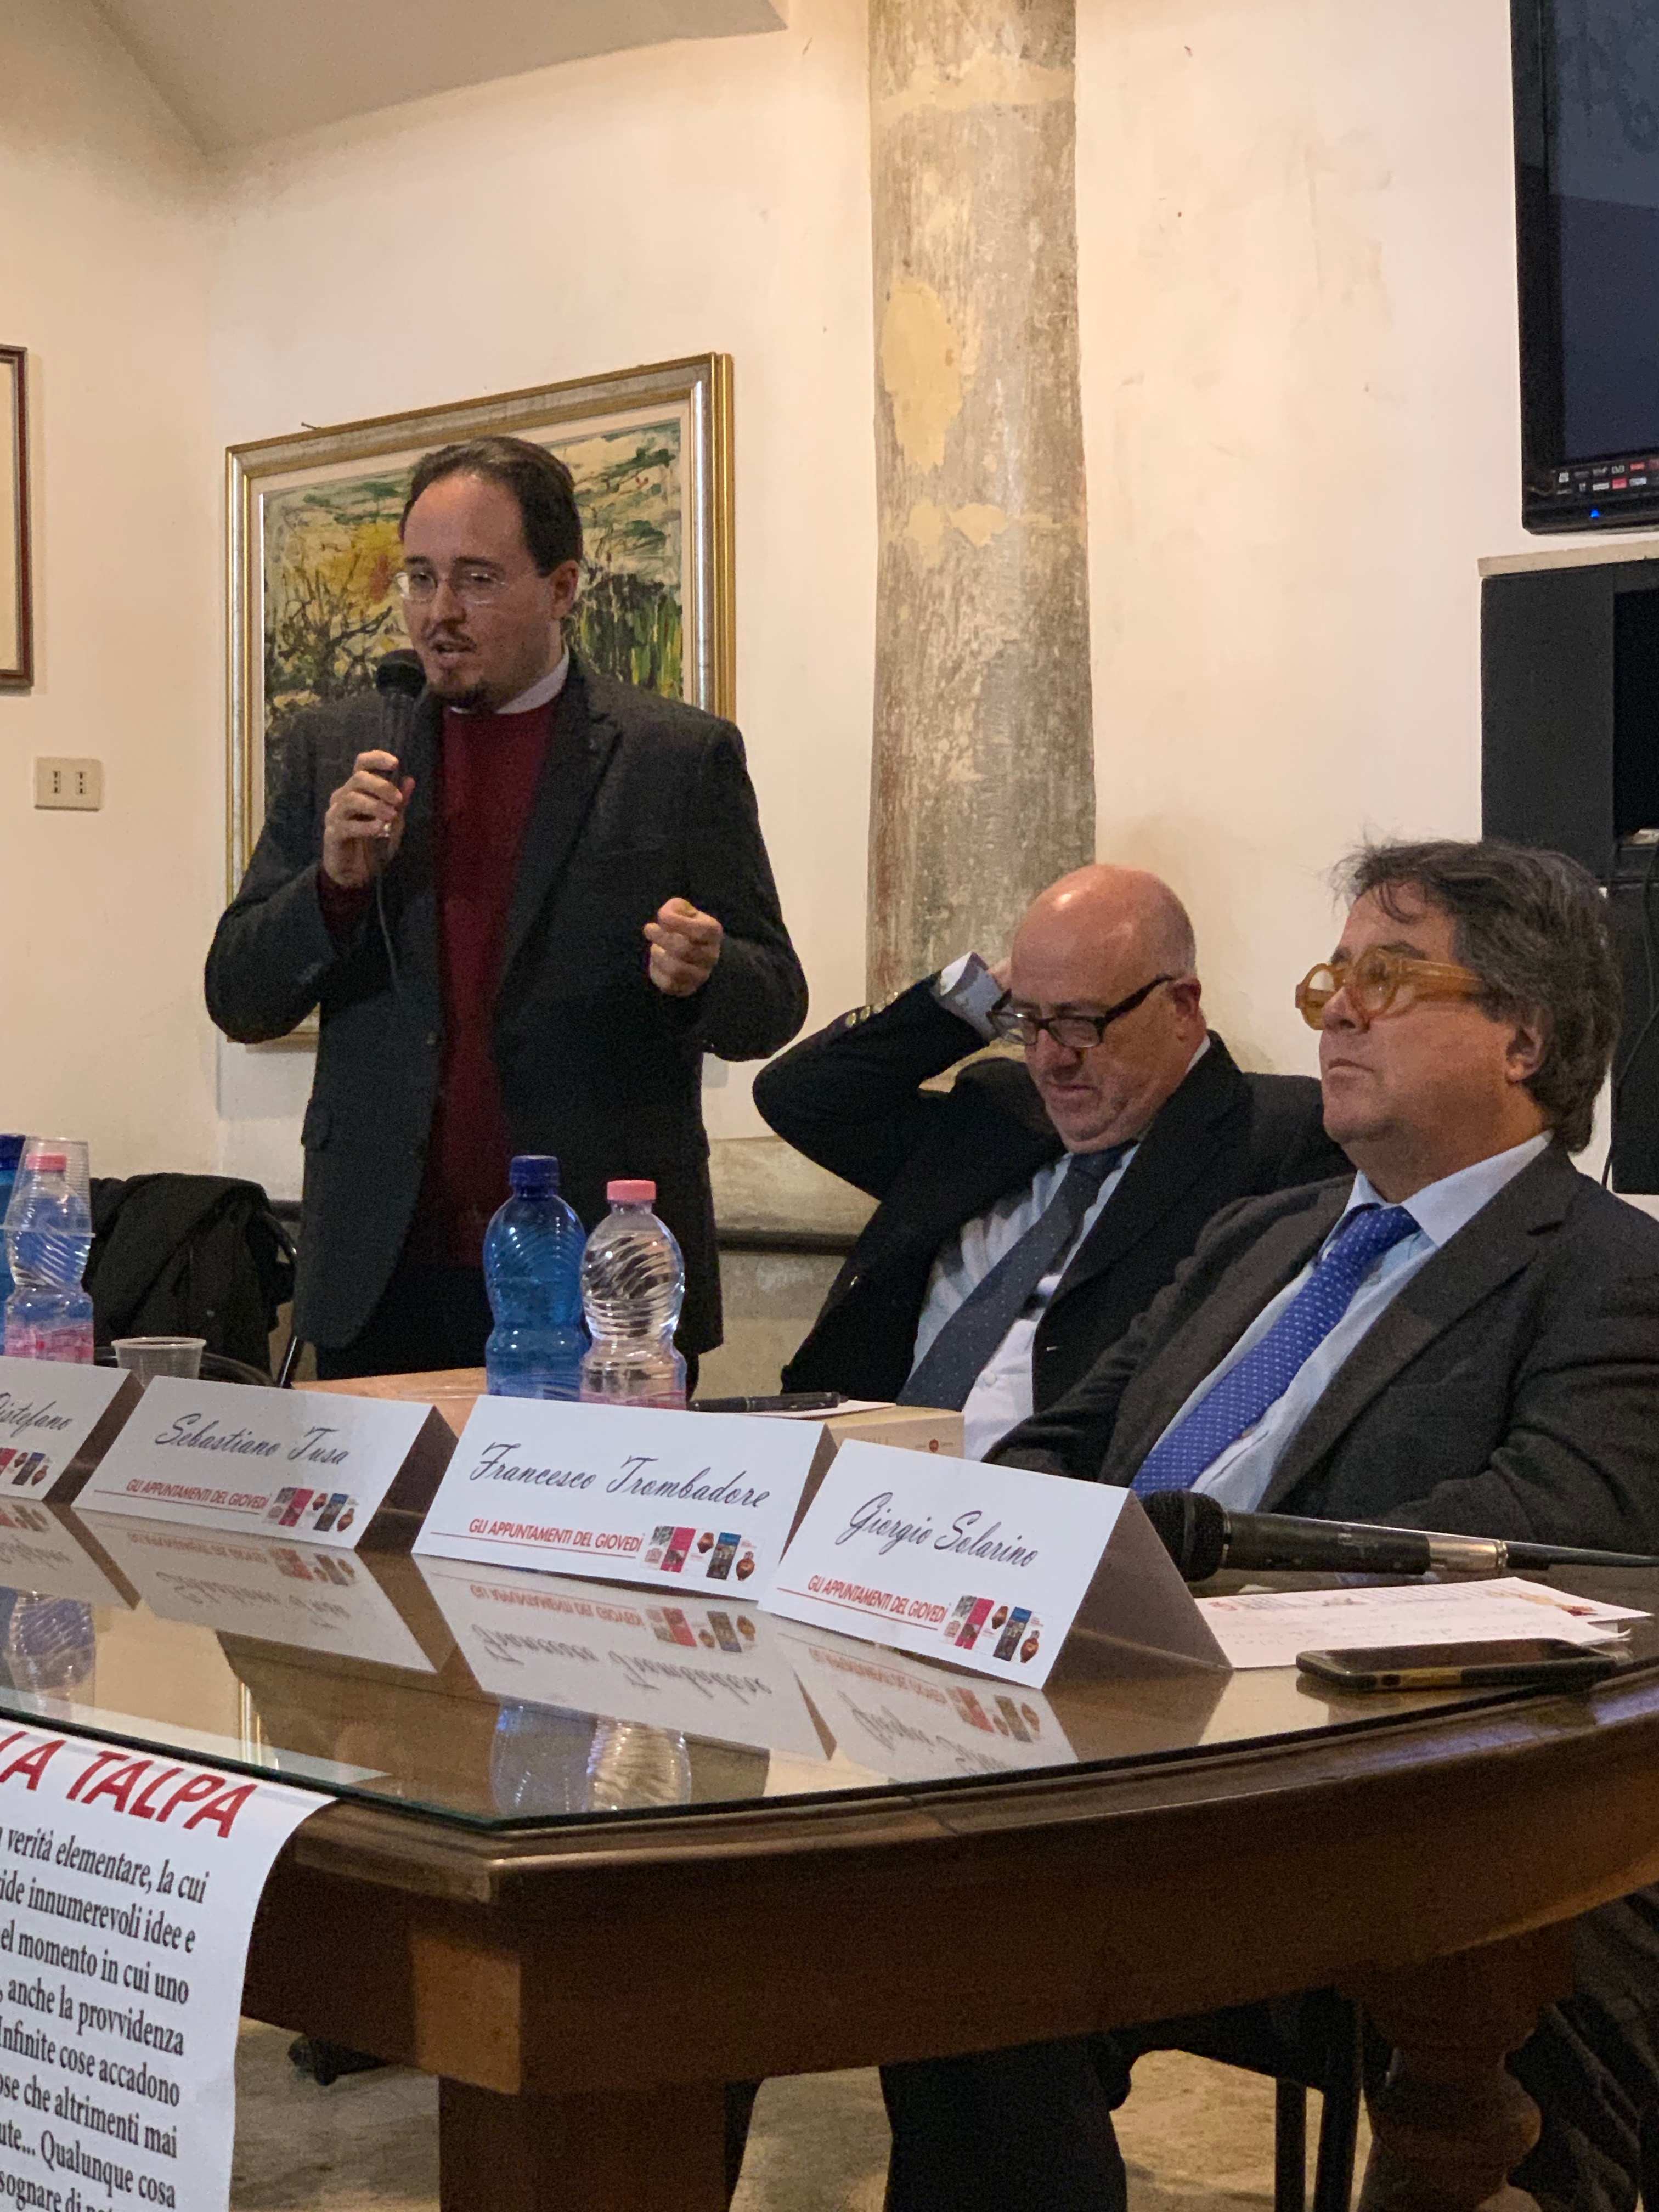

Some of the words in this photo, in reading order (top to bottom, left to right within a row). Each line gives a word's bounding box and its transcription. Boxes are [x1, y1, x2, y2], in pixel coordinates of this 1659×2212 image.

[155, 1413, 281, 1458] Sebastiano
[287, 1426, 349, 1465] Tusa
[469, 1441, 597, 1489] Francesco
[606, 1455, 770, 1508] Trombadore
[126, 1479, 143, 1492] GLI
[143, 1481, 211, 1502] APPUNTAMENTI
[211, 1491, 227, 1504] DEL
[469, 1518, 487, 1533] GLI
[488, 1521, 572, 1544] APPUNTAMENTI
[573, 1531, 593, 1547] DEL
[834, 1491, 933, 1555] Giorgio
[934, 1510, 1039, 1567] Solarino
[808, 1574, 822, 1592] GLI
[823, 1578, 891, 1609] APPUNTAMENTI
[891, 1597, 907, 1615] DEL
[66, 1750, 258, 1838] TALPA
[8, 1827, 54, 1861] verità
[56, 1835, 153, 1894] elementare,
[156, 1858, 174, 1894] la
[178, 1871, 210, 1904] cui
[27, 1876, 143, 1939] innumerevoli
[143, 1909, 182, 1949] idee
[185, 1929, 196, 1953] e
[18, 1932, 98, 1977] momento
[100, 1949, 119, 1984] in
[123, 1961, 151, 1994] cui
[155, 1972, 189, 2004] uno
[8, 1977, 55, 2013] anche
[58, 1984, 73, 2021] la
[76, 2002, 184, 2056] provvidenza
[59, 2046, 95, 2078] cose
[99, 2061, 180, 2107] accadono
[24, 2074, 51, 2112] che
[54, 2086, 139, 2146] altrimenti
[144, 2125, 177, 2158] mai
[41, 2130, 133, 2198] Qualunque
[139, 2174, 176, 2209] cosa
[65, 2187, 81, 2212] di
